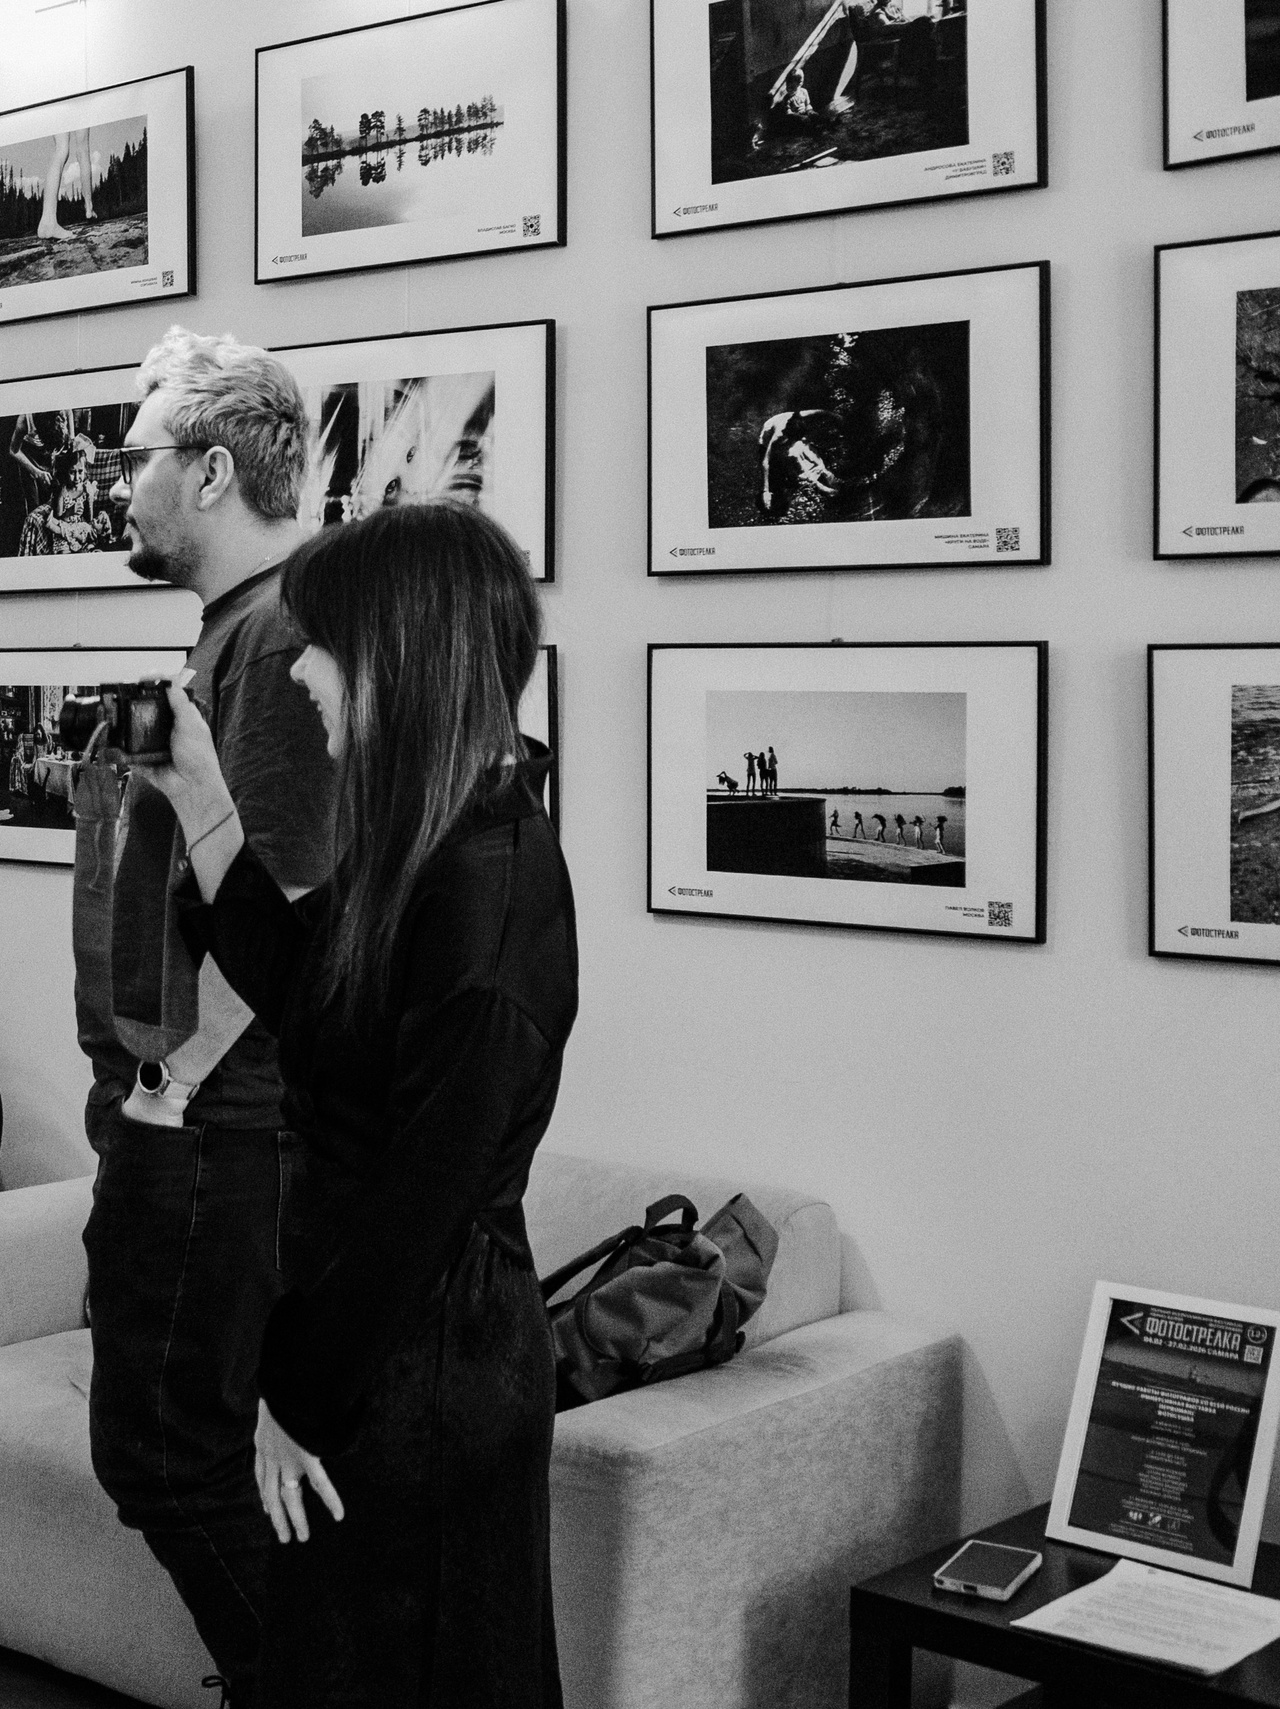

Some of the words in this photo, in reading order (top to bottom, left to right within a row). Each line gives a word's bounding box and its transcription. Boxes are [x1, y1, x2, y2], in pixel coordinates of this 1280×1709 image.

[1206, 123, 1255, 138] ФОТОСТРЕЛКА
[1195, 525, 1244, 536] ФОТОСТРЕЛКА
[1190, 928, 1239, 939] ФОТОСТРЕЛКА
[1146, 1317, 1241, 1350] ФОТОСТРЕЛКА
